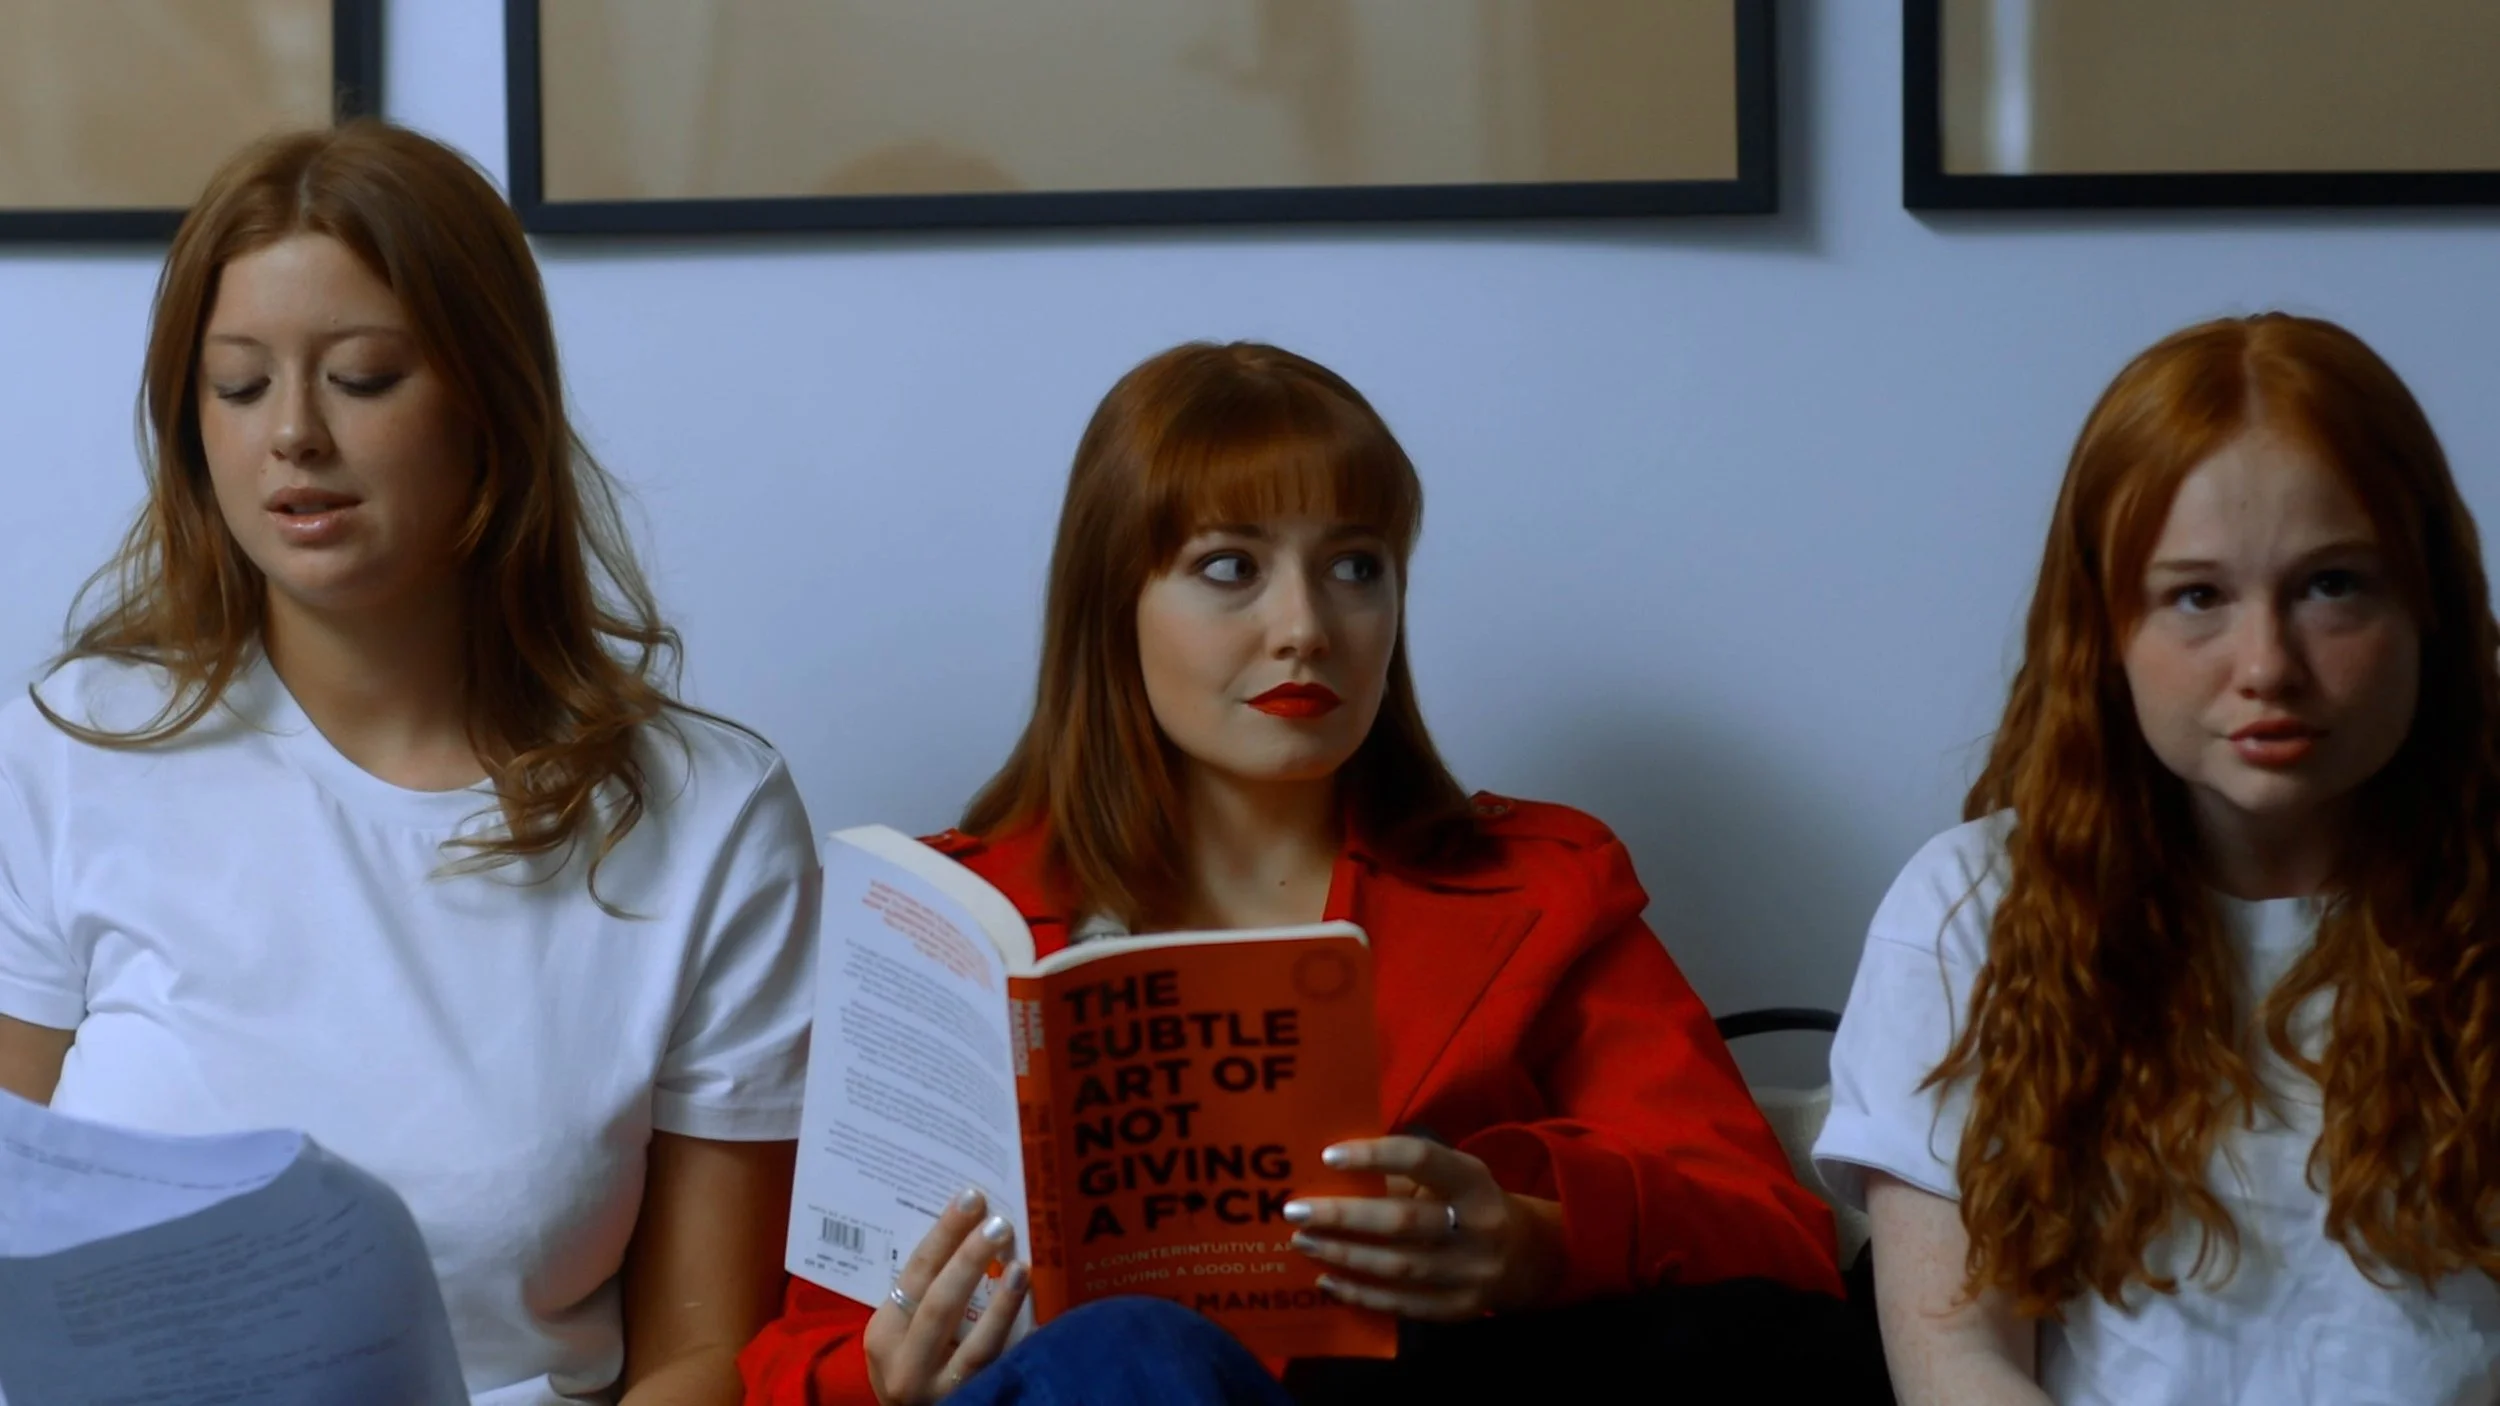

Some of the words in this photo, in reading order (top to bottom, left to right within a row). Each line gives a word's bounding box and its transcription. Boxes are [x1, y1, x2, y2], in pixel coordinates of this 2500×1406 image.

[1062, 970, 1180, 1025] THE
[1067, 1008, 1300, 1071] SUBTLE
[1073, 1057, 1191, 1115] ART
[1211, 1054, 1296, 1093] OF
[1074, 1102, 1200, 1157] NOT
[1079, 1144, 1293, 1197] GIVING
[1082, 1203, 1126, 1244] A
[1084, 1261, 1096, 1273] A
[1100, 1241, 1266, 1269] COUNTERINTUITIVE
[1085, 1281, 1108, 1293] TO
[1113, 1268, 1170, 1287] LIVING
[1176, 1265, 1188, 1277] A
[1193, 1262, 1246, 1275] GOOD
[1249, 1261, 1287, 1274] LIFE
